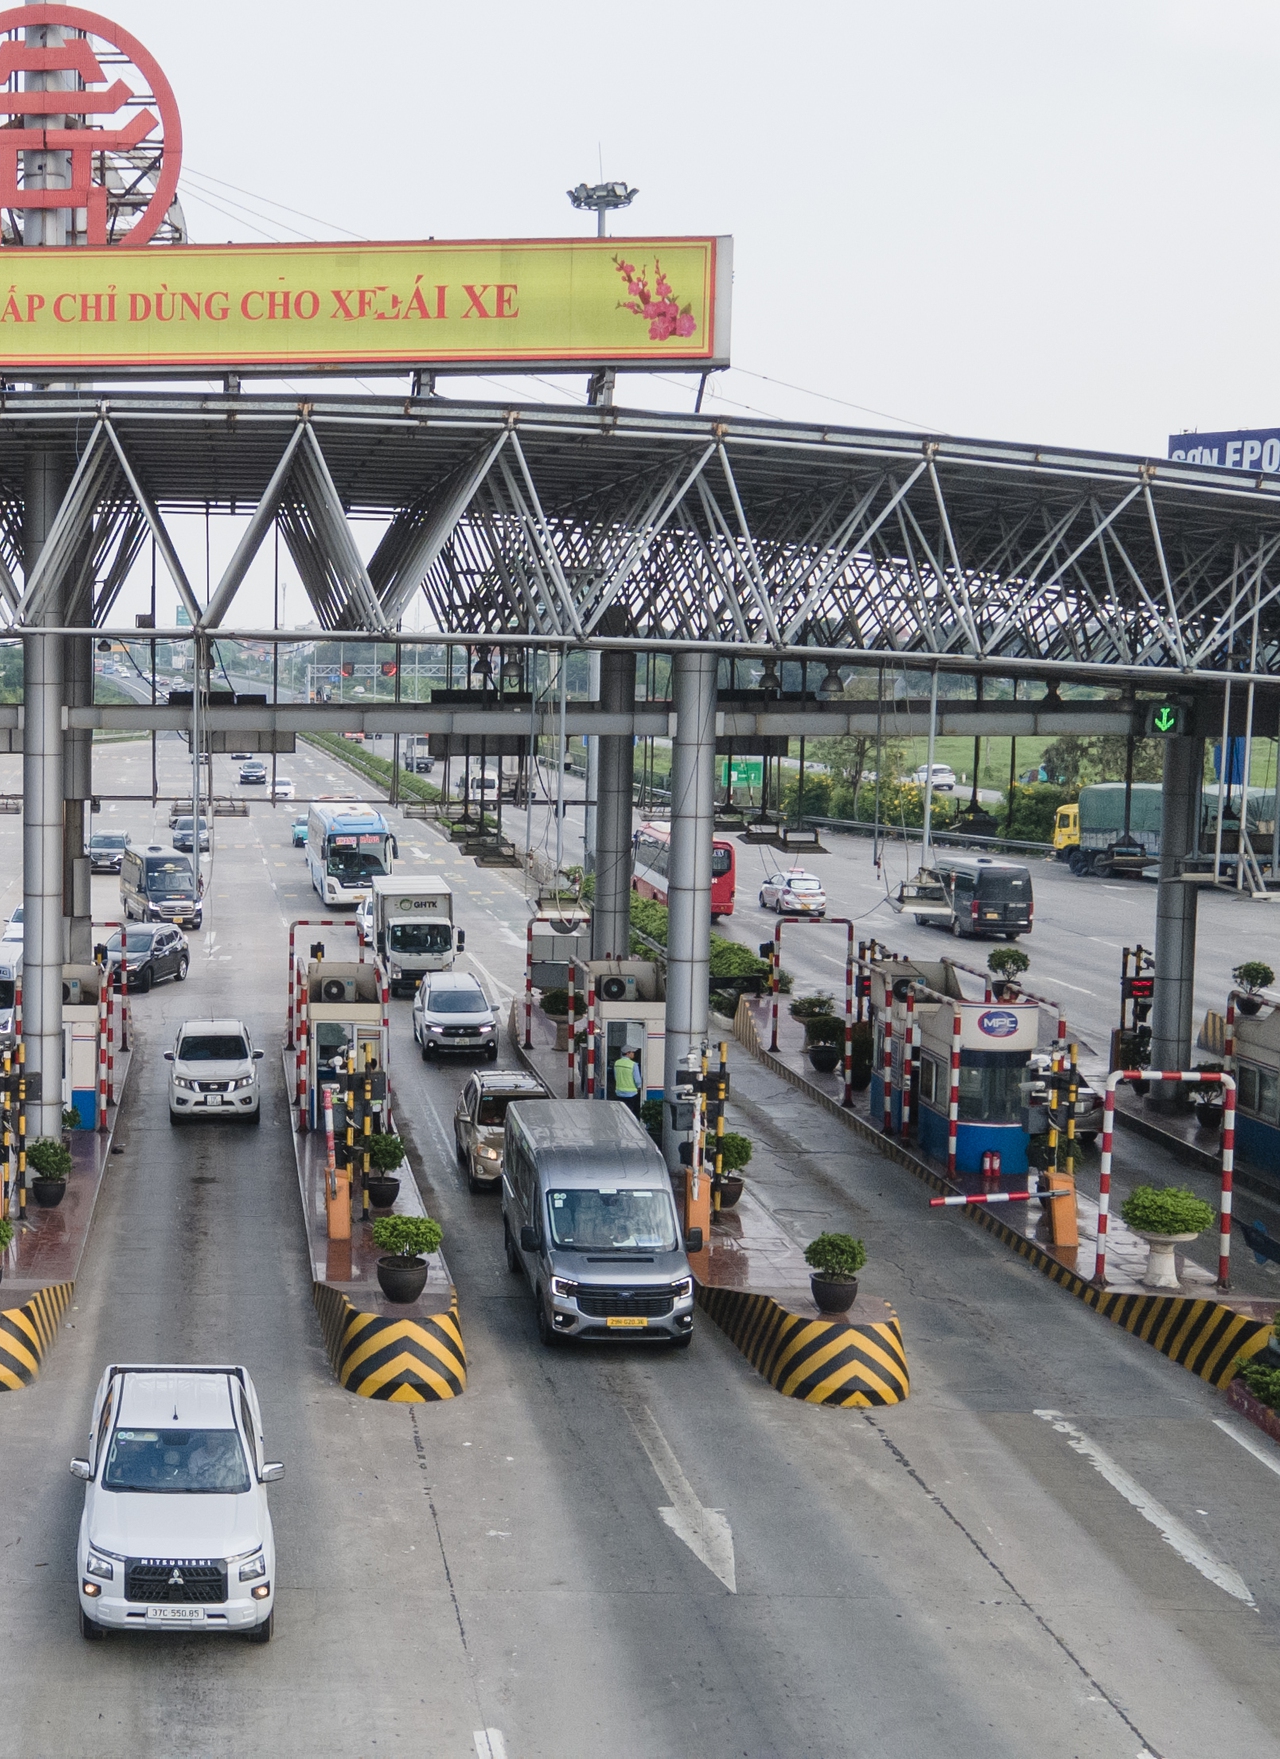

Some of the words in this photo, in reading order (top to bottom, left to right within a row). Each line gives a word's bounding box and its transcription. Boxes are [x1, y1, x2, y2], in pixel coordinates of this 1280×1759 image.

[53, 284, 118, 322] CHỈ
[128, 283, 231, 321] DÙNG
[240, 290, 321, 320] CHO
[460, 283, 520, 319] XE
[413, 900, 438, 909] GHTK
[983, 1017, 1017, 1028] MPC
[140, 1558, 212, 1566] MITSUBISHI
